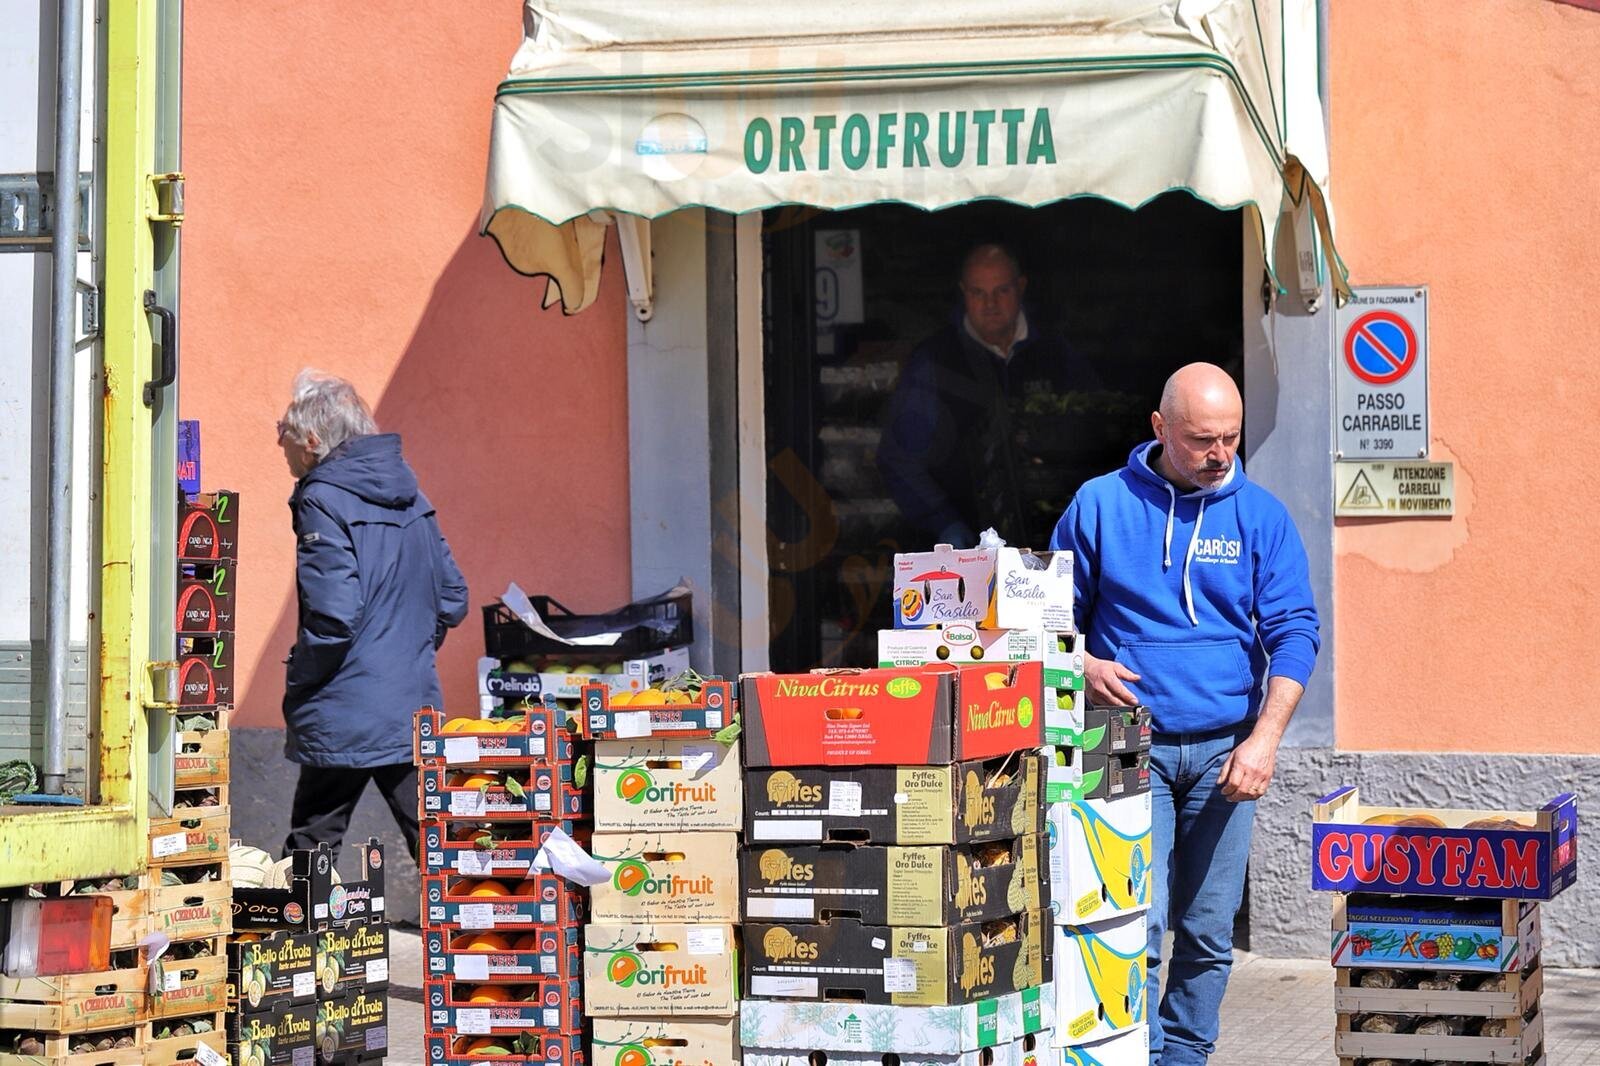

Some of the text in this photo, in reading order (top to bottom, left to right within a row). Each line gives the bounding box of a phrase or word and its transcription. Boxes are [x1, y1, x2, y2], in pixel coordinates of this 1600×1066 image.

[744, 107, 1056, 174] ORTOFRUTTA
[1358, 393, 1405, 410] PASSO
[1342, 414, 1421, 431] CARRABILE
[1373, 438, 1394, 450] 3390
[1393, 467, 1446, 480] ATTENZIONE
[1398, 483, 1441, 495] CARRELLI
[1399, 498, 1451, 510] MOVIMENTO
[958, 556, 976, 564] Passion
[1005, 570, 1031, 585] San
[932, 588, 953, 602] San
[1006, 585, 1046, 599] Basilio
[932, 601, 979, 619] Basilio
[487, 676, 541, 693] Melinda
[775, 677, 880, 698] NivaCitrus
[967, 701, 1016, 733] NivaCitrus
[912, 771, 936, 781] Fyffes
[904, 780, 943, 788] Oro Dulce
[646, 782, 716, 806] orifruit
[902, 852, 926, 862] Fyffes
[1318, 831, 1541, 890] GUSYFAM
[895, 861, 933, 869] Oro Dulce
[643, 873, 714, 897] orifruit
[174, 907, 211, 921] CERICOLA
[1369, 915, 1413, 923] SELEZIONATI
[326, 931, 350, 953] Bello
[899, 940, 913, 948] Oro
[907, 932, 931, 941] Fyffes
[252, 944, 276, 965] Bello
[637, 964, 707, 989] orifruit
[84, 996, 126, 1012] CERICOLA
[324, 1001, 349, 1022] Bello
[251, 1019, 275, 1041] Bello
